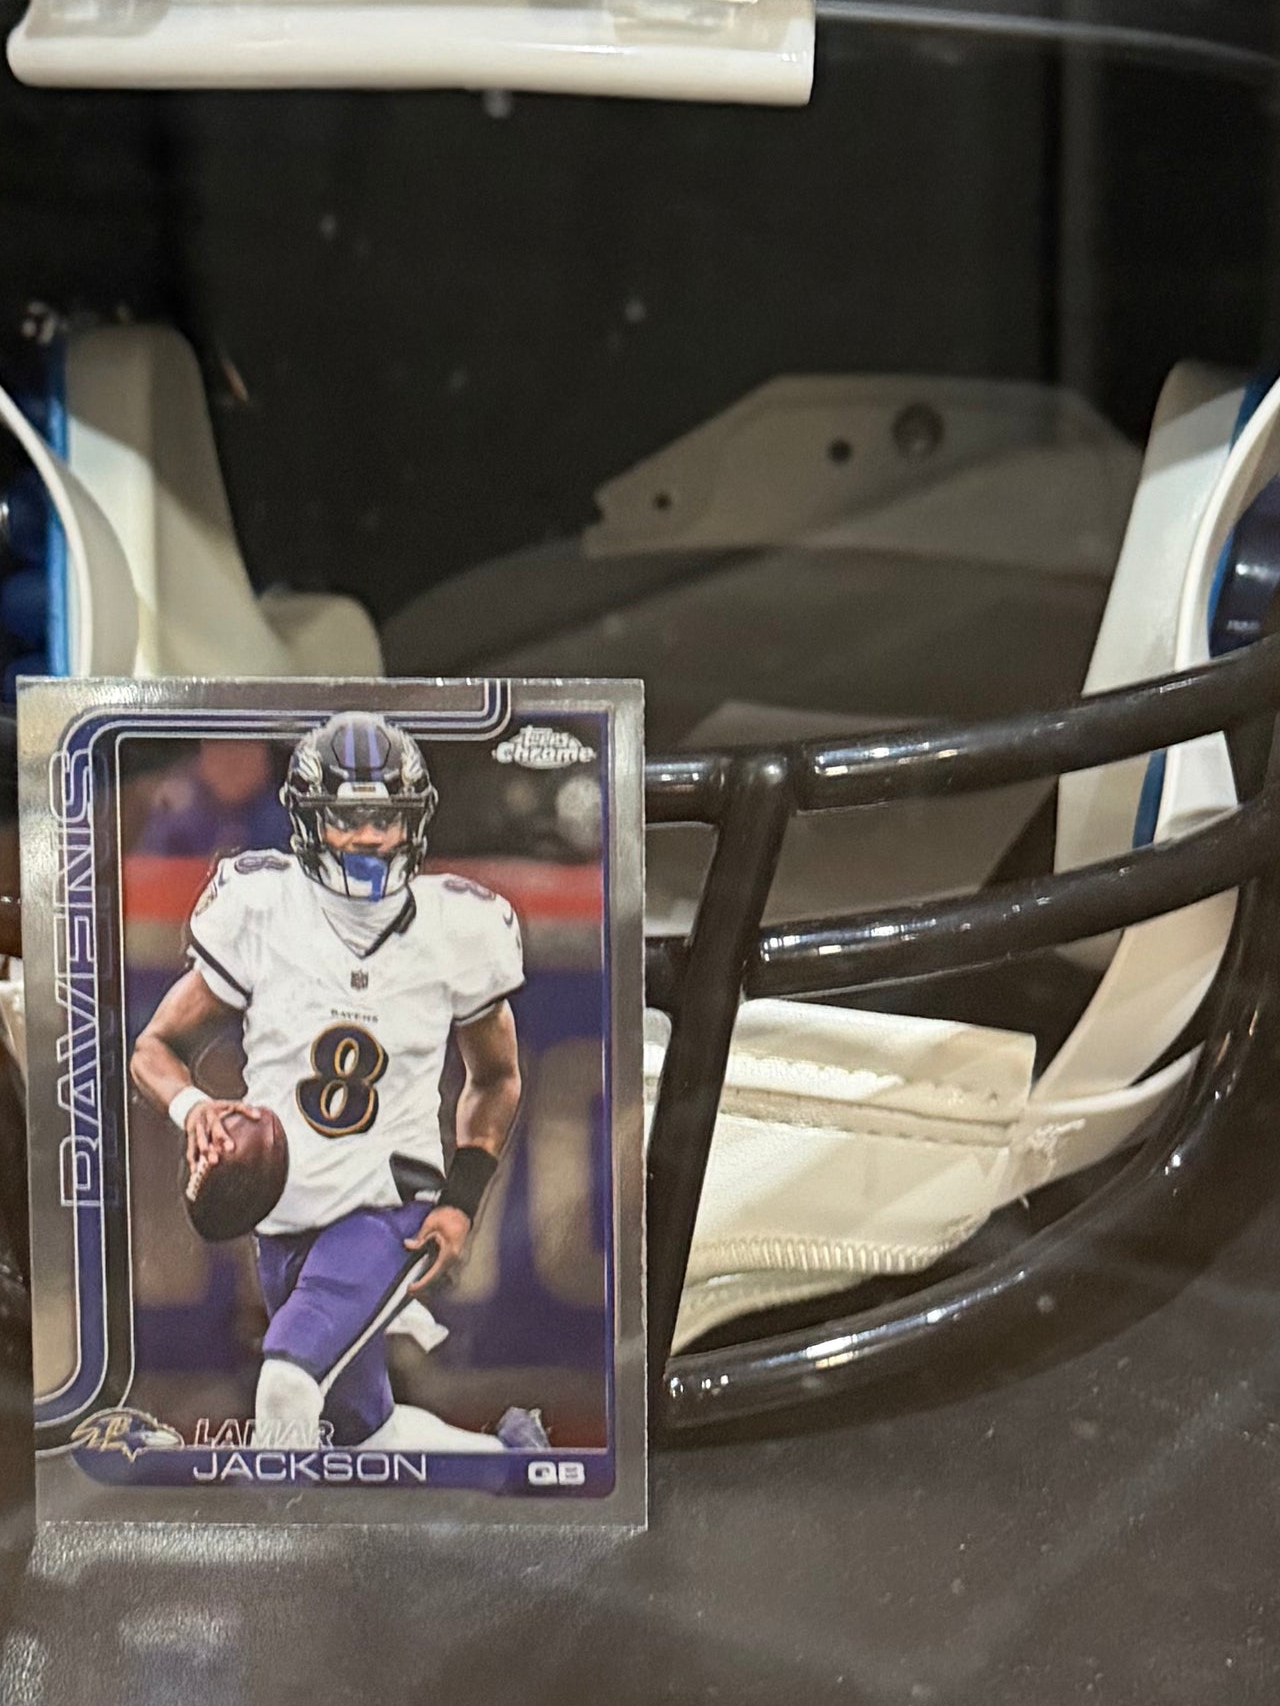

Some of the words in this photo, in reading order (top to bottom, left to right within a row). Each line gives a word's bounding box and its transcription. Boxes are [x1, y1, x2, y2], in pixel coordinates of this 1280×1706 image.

[495, 741, 596, 764] Chrome
[49, 748, 118, 1208] RAVENS
[295, 1020, 389, 1139] 8
[193, 1417, 336, 1450] LAMAR
[193, 1452, 427, 1482] JACKSON
[527, 1460, 586, 1486] QB
